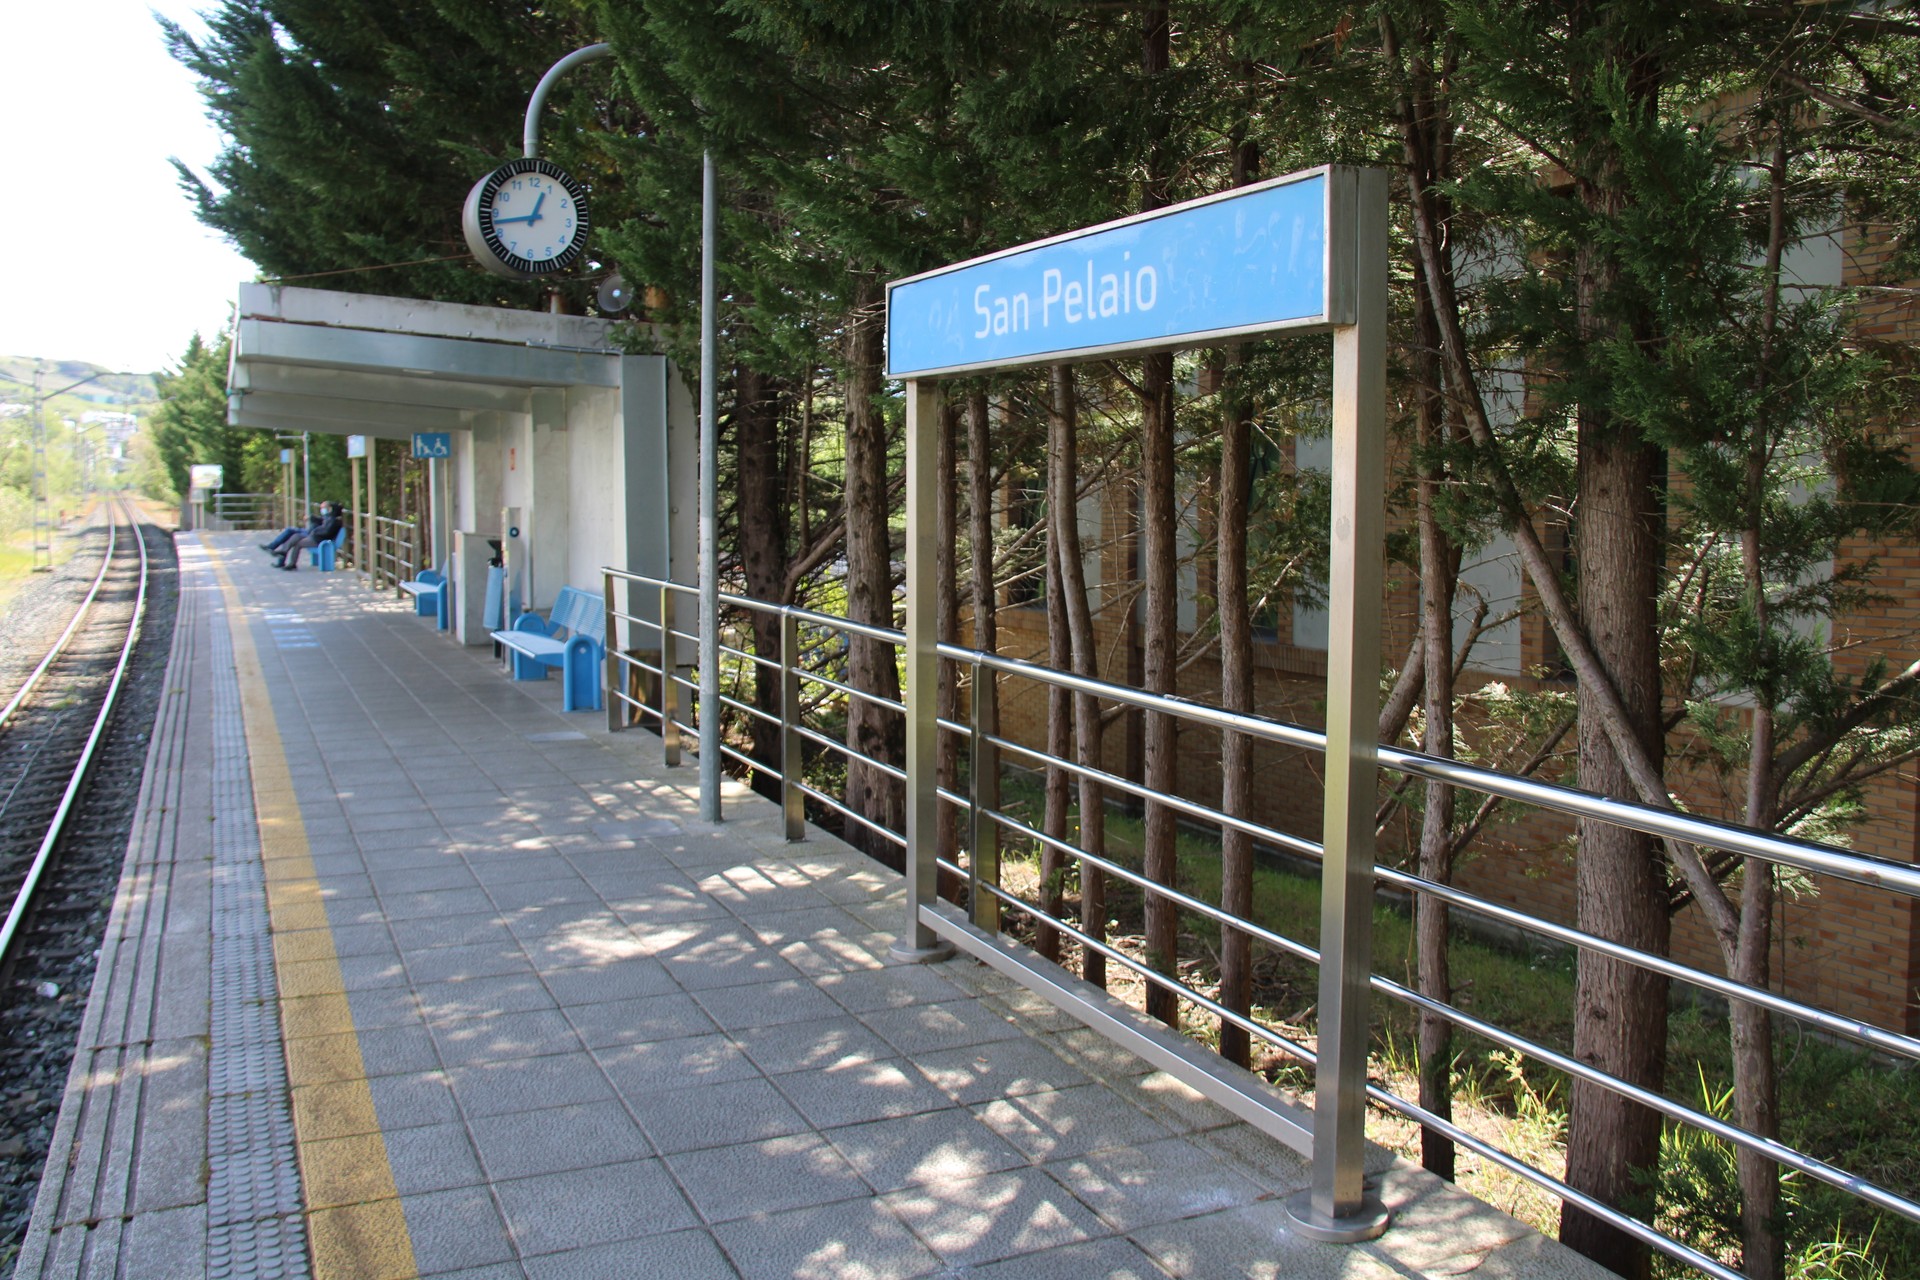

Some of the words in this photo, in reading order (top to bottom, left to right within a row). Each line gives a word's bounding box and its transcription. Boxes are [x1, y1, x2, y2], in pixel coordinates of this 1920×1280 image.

[511, 180, 522, 191] 11
[528, 177, 541, 188] 12
[547, 185, 552, 194] 1
[498, 192, 510, 202] 10
[561, 199, 567, 208] 2
[492, 208, 499, 218] 9
[566, 218, 572, 228] 3
[497, 228, 504, 238] 8
[558, 235, 565, 244] 4
[511, 242, 517, 251] 7
[527, 249, 534, 259] 6
[545, 247, 552, 257] 5
[974, 284, 1029, 339] San
[1043, 251, 1157, 327] Pelaio
